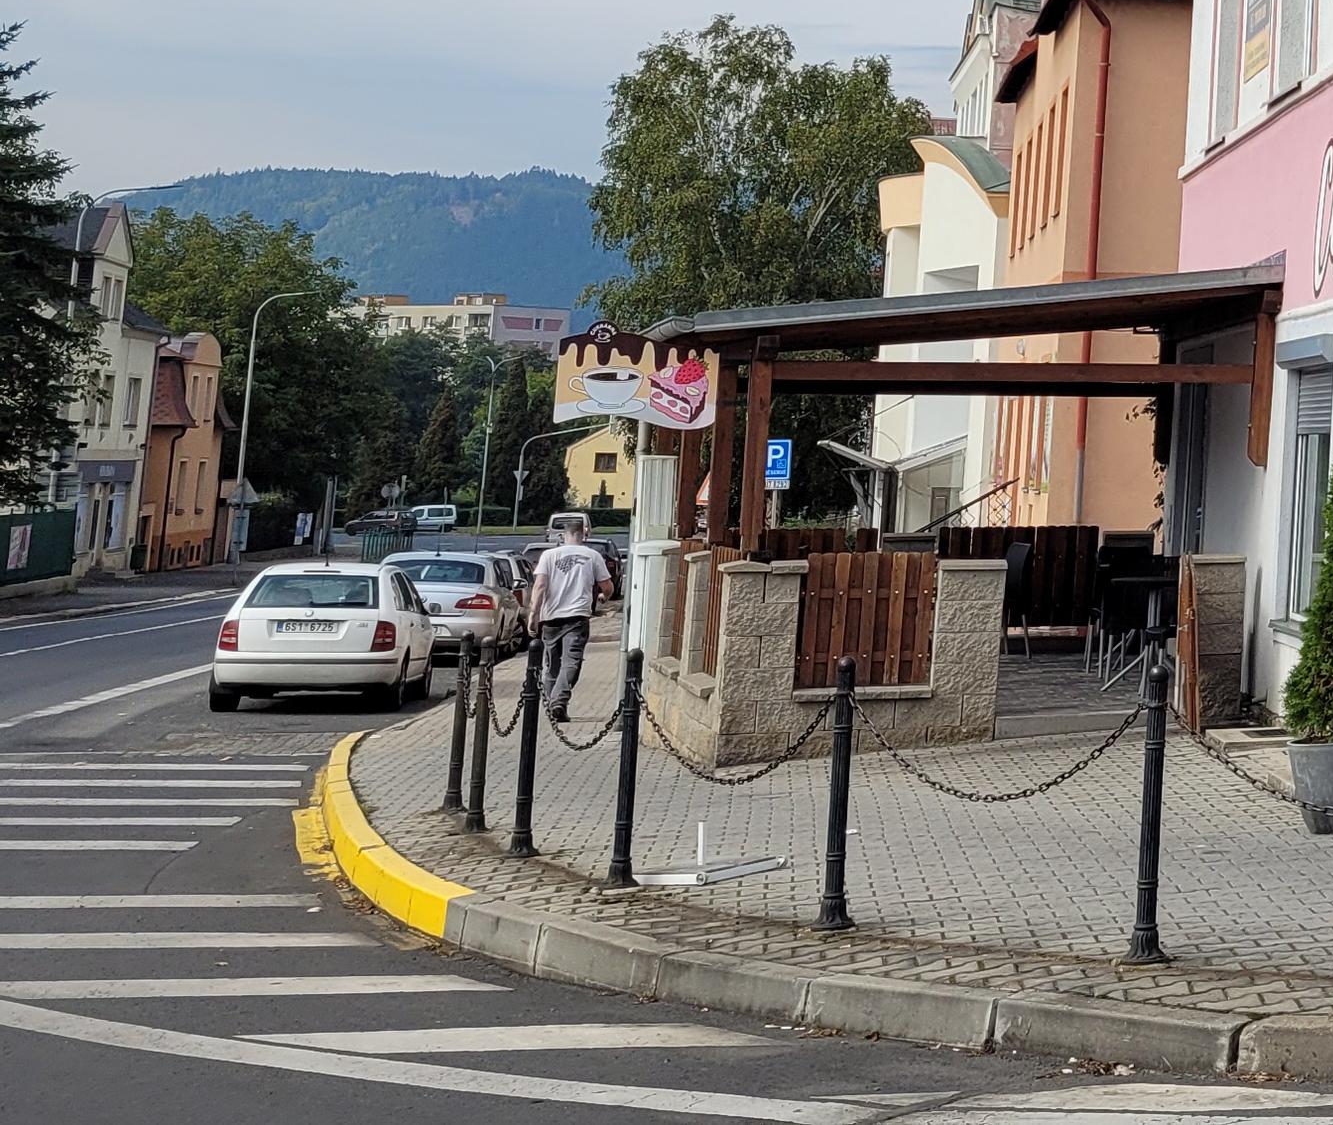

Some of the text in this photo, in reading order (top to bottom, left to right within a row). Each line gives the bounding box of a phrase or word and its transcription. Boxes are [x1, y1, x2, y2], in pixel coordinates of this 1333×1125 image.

[768, 445, 784, 467] P
[285, 621, 334, 632] 6S1 6725
